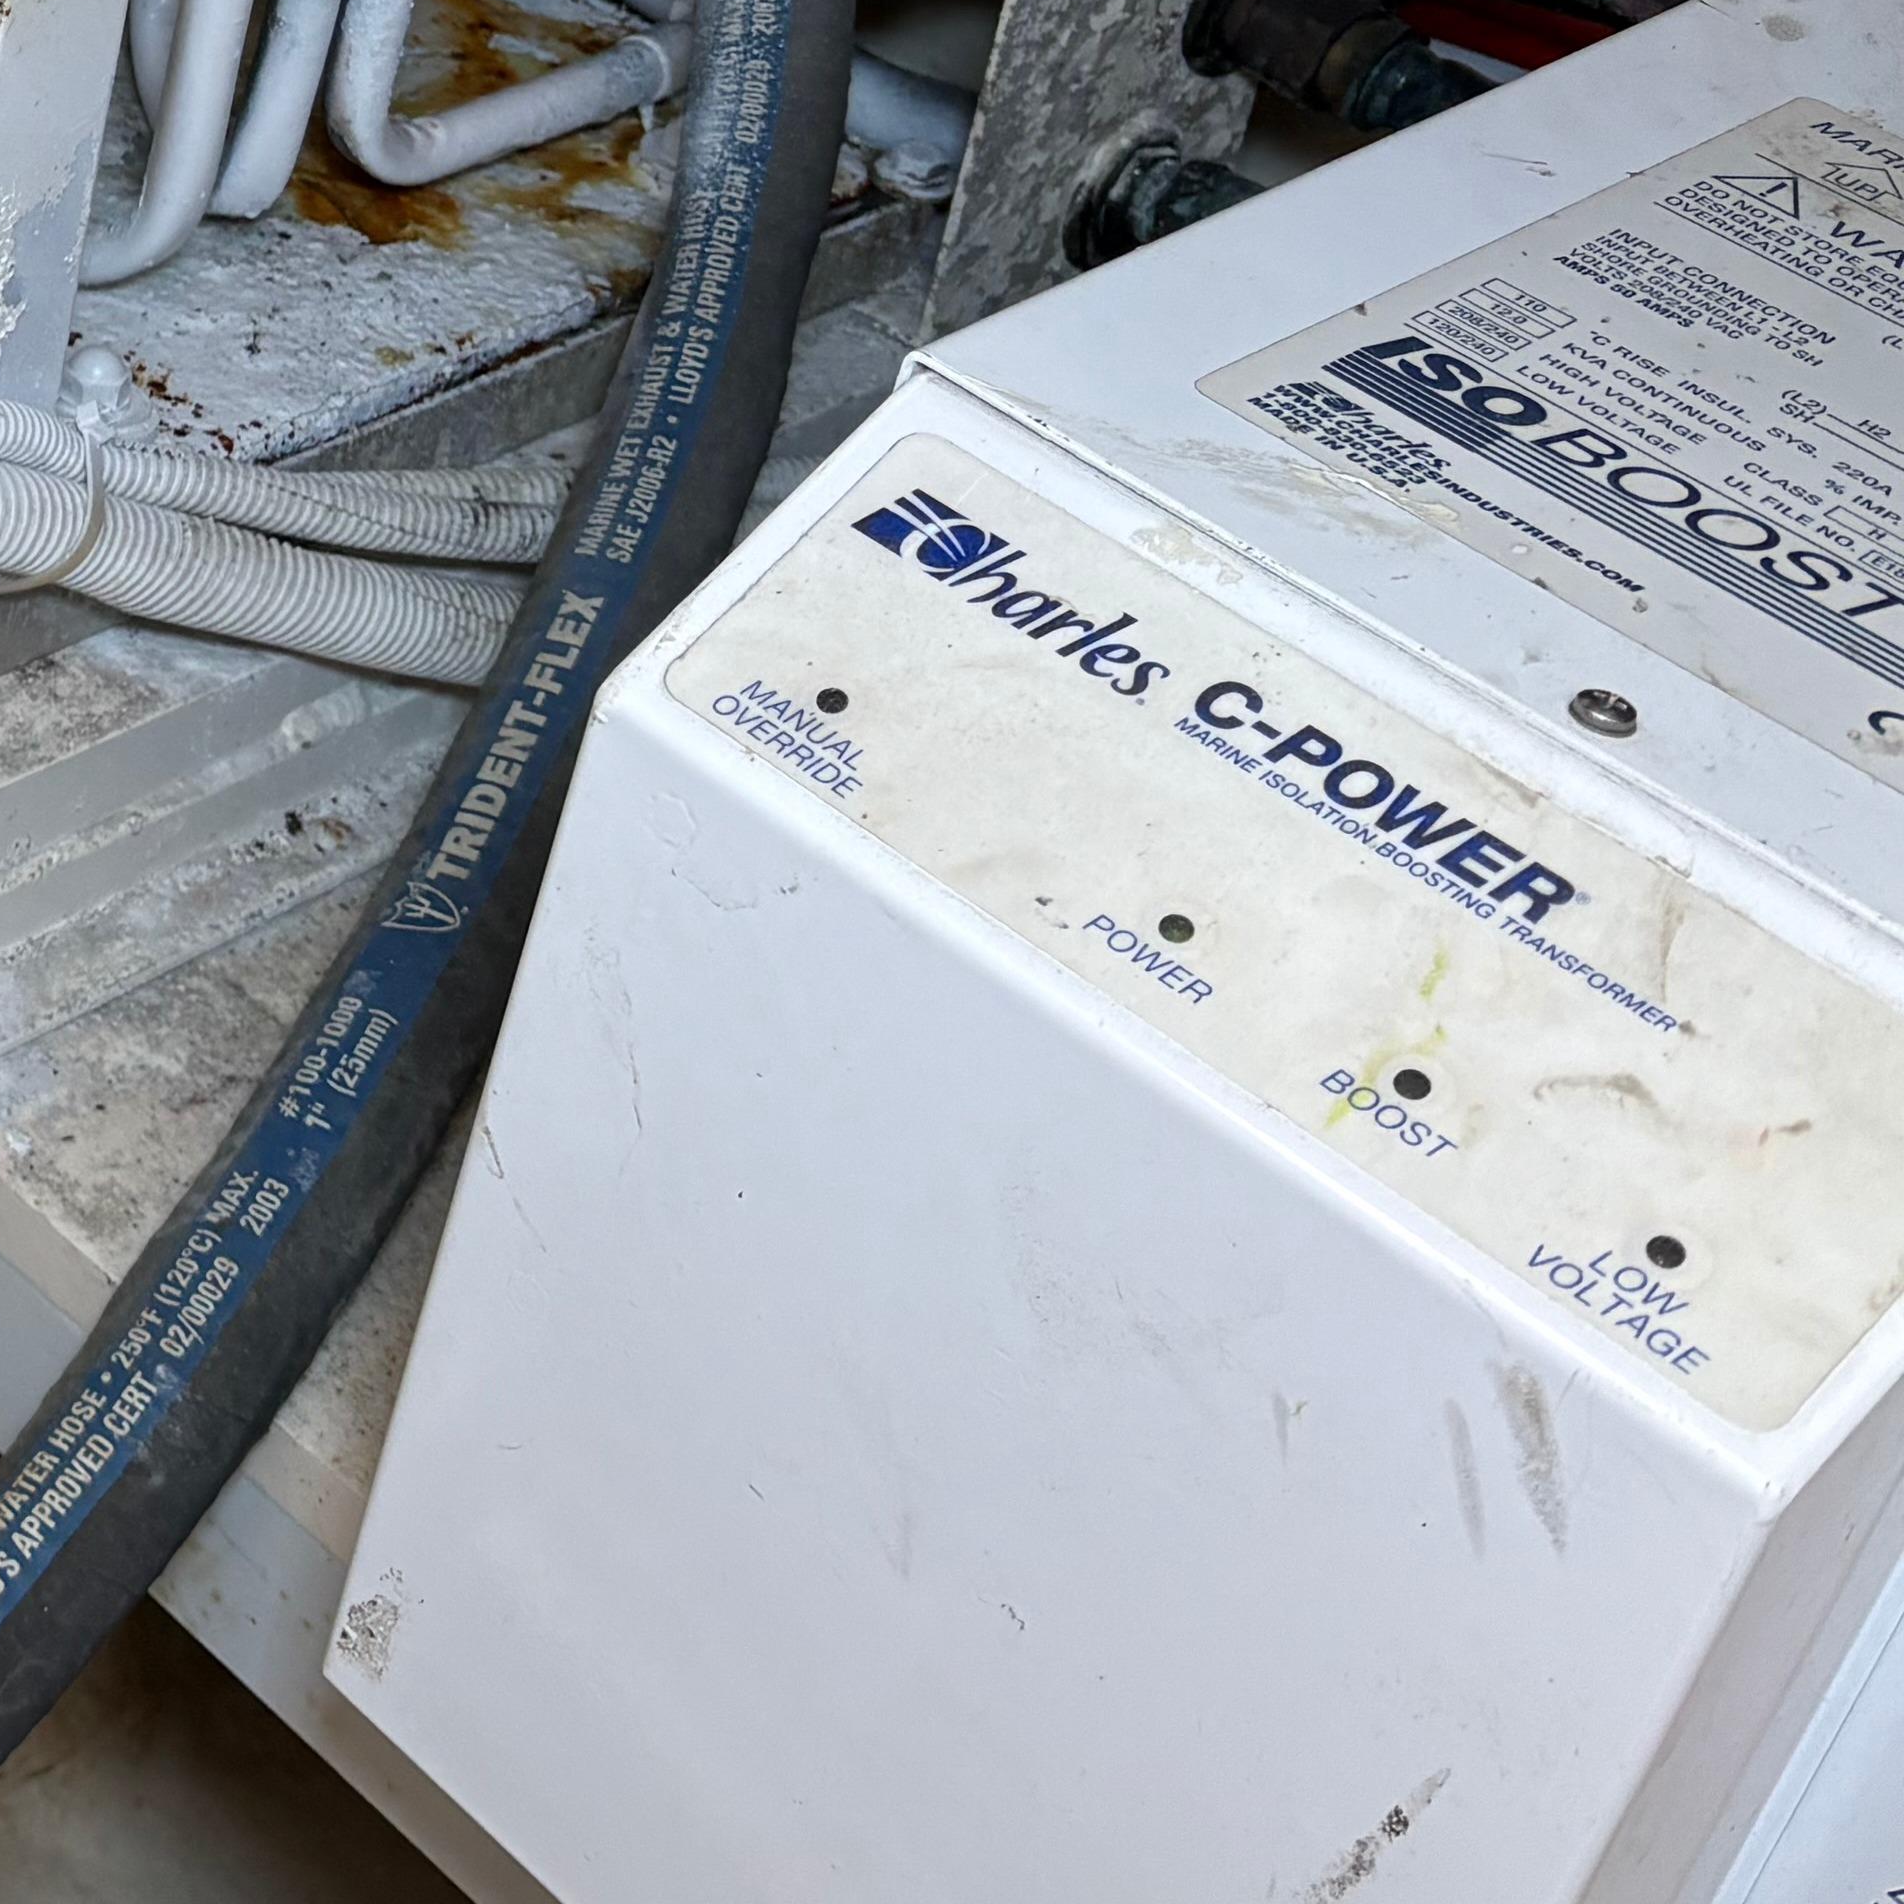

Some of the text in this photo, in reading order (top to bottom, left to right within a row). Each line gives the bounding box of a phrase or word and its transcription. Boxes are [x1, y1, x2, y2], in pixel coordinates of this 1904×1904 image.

[1677, 188, 1833, 265] DESIGNED TO
[1692, 180, 1865, 267] DO NOT STORE
[1833, 172, 1880, 194] UP
[1552, 255, 1611, 285] AMPS
[1634, 298, 1695, 328] AMPS
[1608, 228, 1837, 345] INPUT CONNECTION
[1664, 195, 1865, 298] OVERHEATING OR
[666, 325, 715, 406] LLOYD'S
[696, 215, 740, 328] APPROVED
[574, 479, 627, 558] MARINE
[606, 429, 644, 486] WET
[625, 342, 678, 430] EXHAUST
[1246, 396, 1411, 493] MADE IN U.S.A.
[1428, 315, 1855, 553] 120/240 LOW VOLTAGE UL FILE NO.
[1447, 302, 1521, 348] 208/240
[1538, 353, 1601, 388] HIGH
[1604, 386, 1708, 445] VOLTAGE
[1743, 462, 1824, 507] CLASS
[1514, 294, 1893, 497] 110 RISE INSUL. SYS. 220A
[1561, 342, 1607, 370] KVA
[1612, 369, 1767, 452] CONTINUOUS
[1781, 389, 1828, 419] (L2)
[1857, 419, 1892, 440] H2
[605, 432, 678, 564] SAE J2006-R2
[1273, 383, 1646, 593] WWW.CHARLESINDUSTRIES.COM
[886, 496, 1171, 705] Charles
[426, 589, 607, 882] TRIDENT-FLEX
[712, 694, 864, 799] OVERRIDE
[739, 679, 864, 772] MANUAL
[1182, 680, 1576, 925] C-POWER
[1173, 717, 1678, 1032] MARINE ISOLATION BOOSTING TRANSFORMER
[1081, 913, 1213, 1004] POWER
[278, 995, 363, 1118] #100-1000
[326, 1007, 399, 1098] (25mm)
[1319, 1068, 1459, 1157] BOOST
[1527, 1243, 1711, 1375] VOLTAGE
[1588, 1250, 1690, 1316] LOW
[10, 1434, 115, 1560] APPROVED
[103, 1370, 159, 1439] CERT
[158, 1255, 240, 1358] 02/00029
[238, 1177, 291, 1238] 2003
[48, 1386, 106, 1452] HOSE
